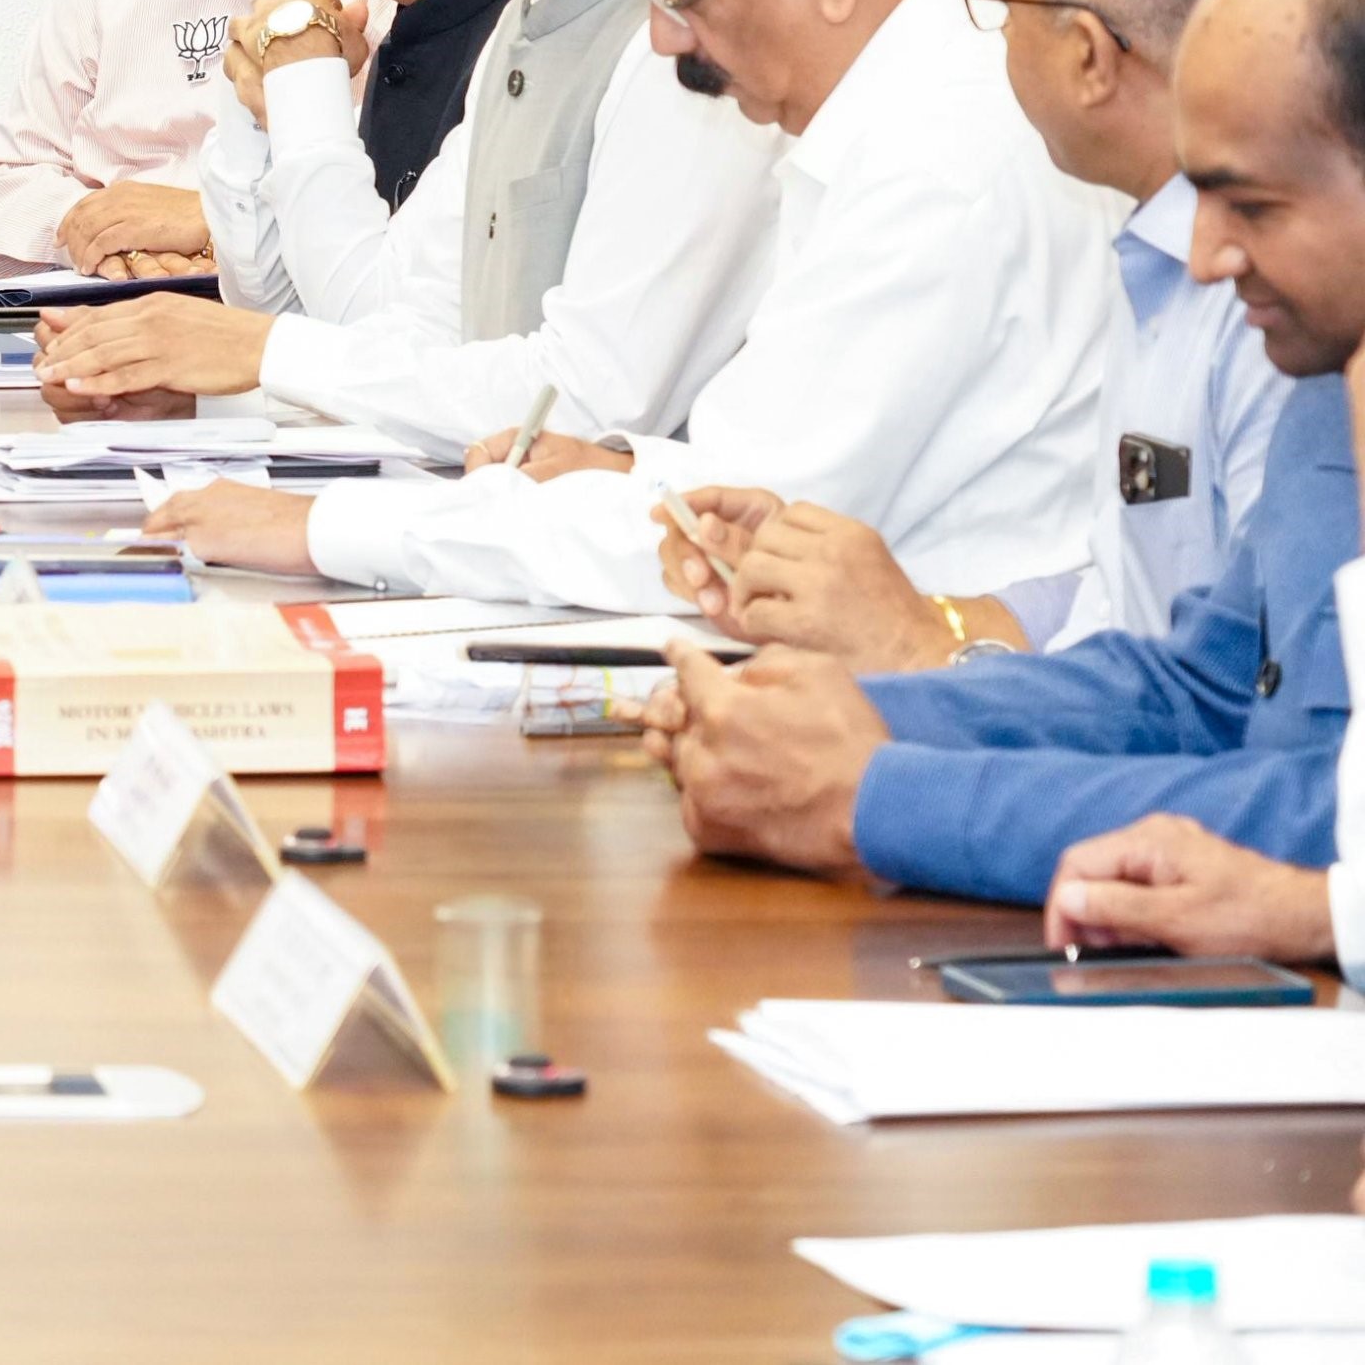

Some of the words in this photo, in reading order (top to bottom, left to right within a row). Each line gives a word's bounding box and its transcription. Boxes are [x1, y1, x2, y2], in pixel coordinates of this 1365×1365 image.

[58, 702, 132, 719] MOTOR
[242, 701, 295, 717] LAWS
[85, 724, 110, 741] IN
